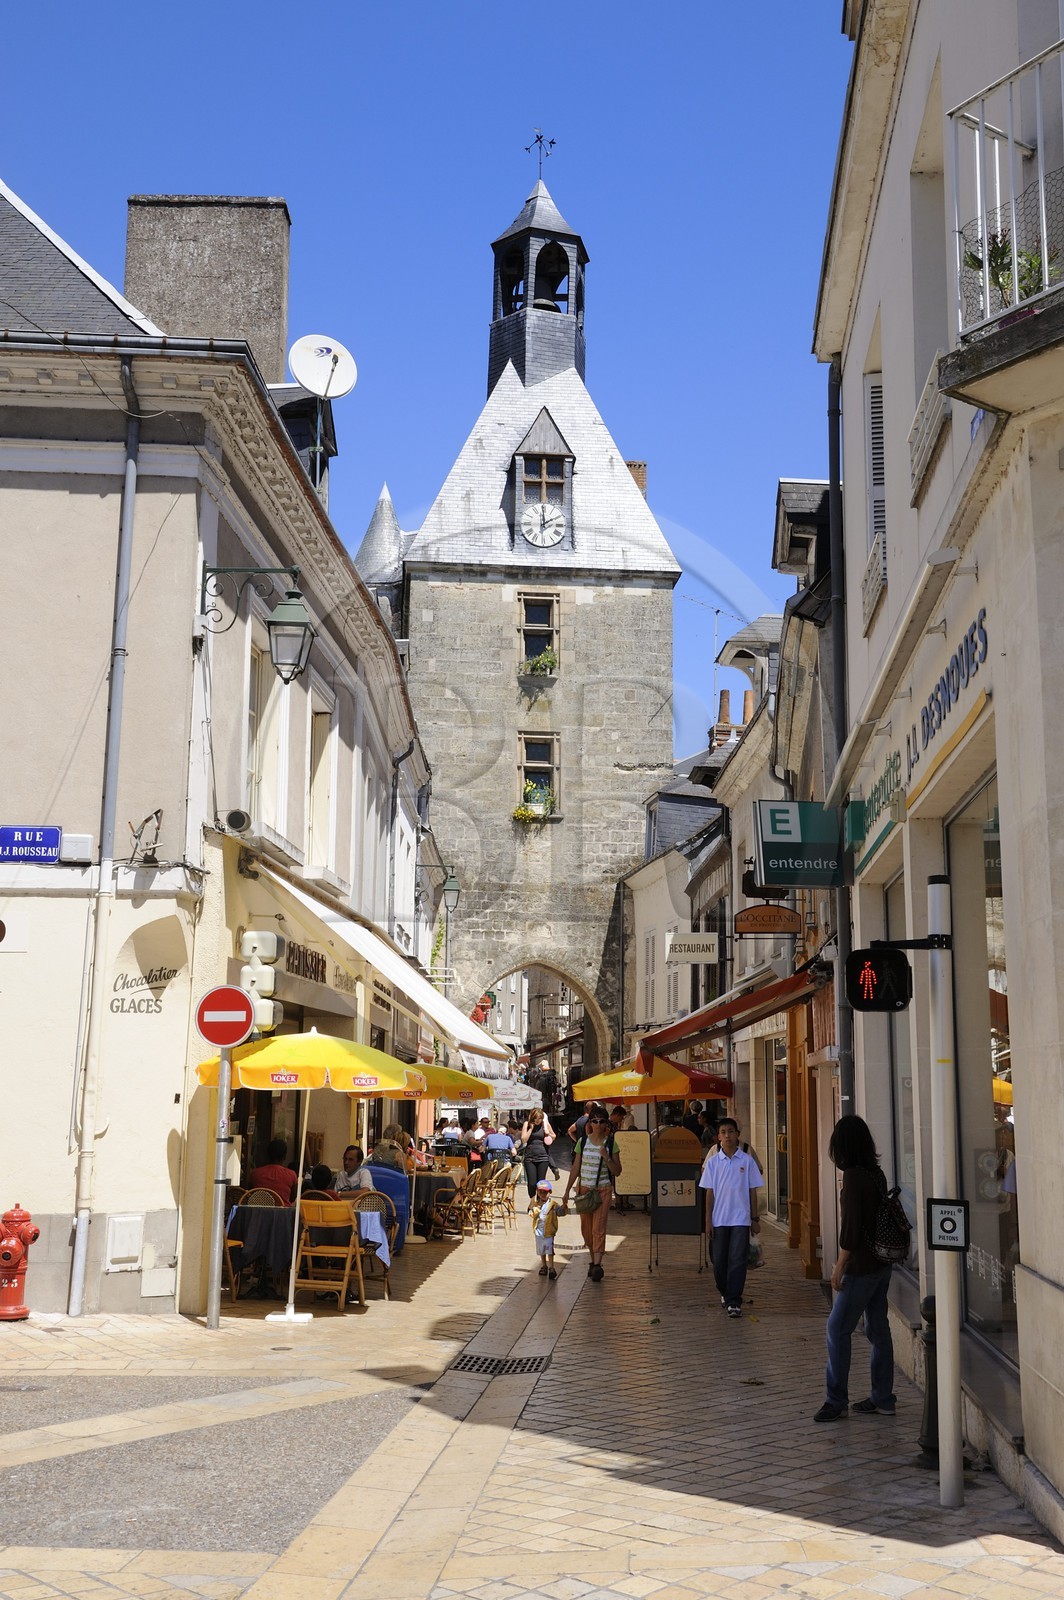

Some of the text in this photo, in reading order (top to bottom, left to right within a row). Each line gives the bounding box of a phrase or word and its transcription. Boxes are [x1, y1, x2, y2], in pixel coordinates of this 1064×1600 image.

[920, 607, 988, 751] DESNOUES
[769, 808, 793, 836] E
[13, 831, 44, 842] RUE
[12, 846, 59, 857] ROUSSEAU
[768, 857, 839, 870] entendre
[740, 913, 797, 923] L'OCCITANE
[669, 943, 716, 954] RESTAURANT
[113, 966, 182, 993] Chocolatier
[109, 998, 163, 1014] GLACES
[273, 1074, 297, 1083] JOKER
[354, 1078, 377, 1086] JOKER
[622, 1085, 640, 1093] MIKO
